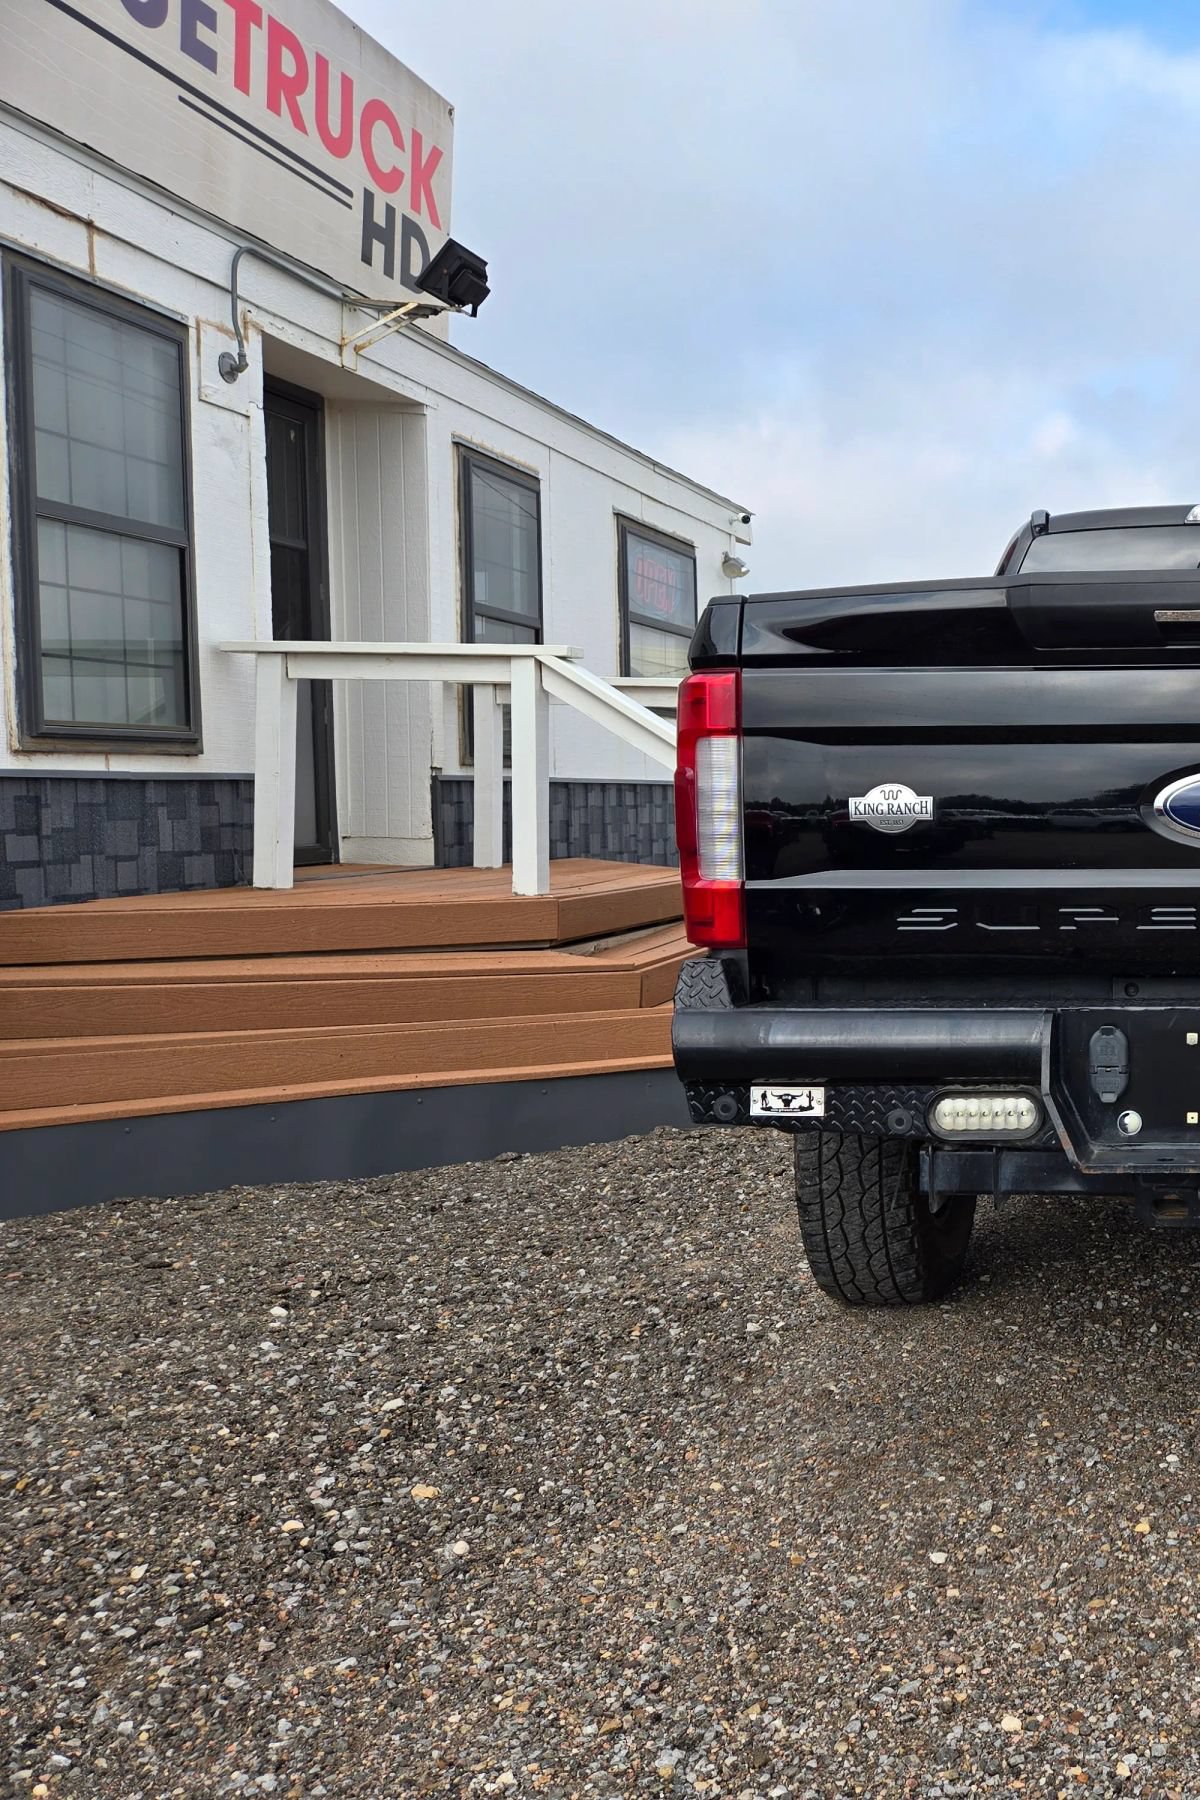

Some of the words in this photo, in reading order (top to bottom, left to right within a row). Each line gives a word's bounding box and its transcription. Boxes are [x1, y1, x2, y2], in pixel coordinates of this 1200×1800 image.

[360, 187, 431, 295] HD
[853, 801, 884, 816] KING
[887, 800, 929, 815] RANCH
